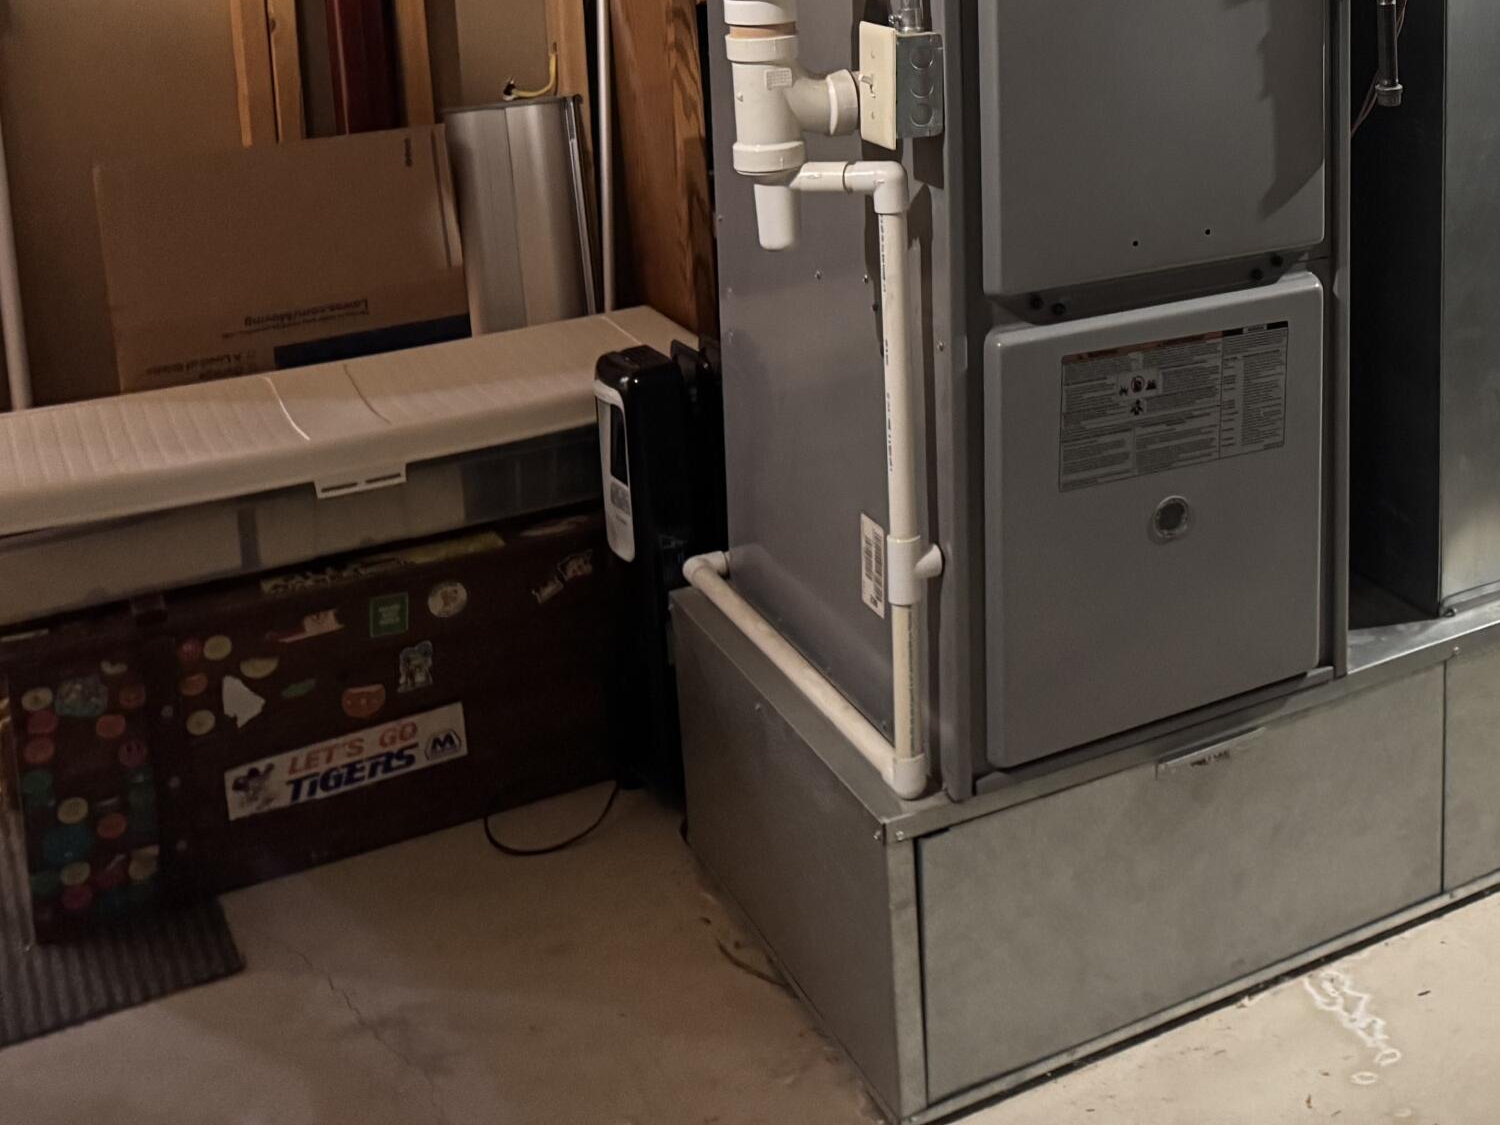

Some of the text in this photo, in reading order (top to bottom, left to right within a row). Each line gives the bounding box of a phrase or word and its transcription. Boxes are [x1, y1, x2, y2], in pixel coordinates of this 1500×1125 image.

[286, 743, 419, 803] TIGERS
[288, 722, 418, 776] LET'S GO
